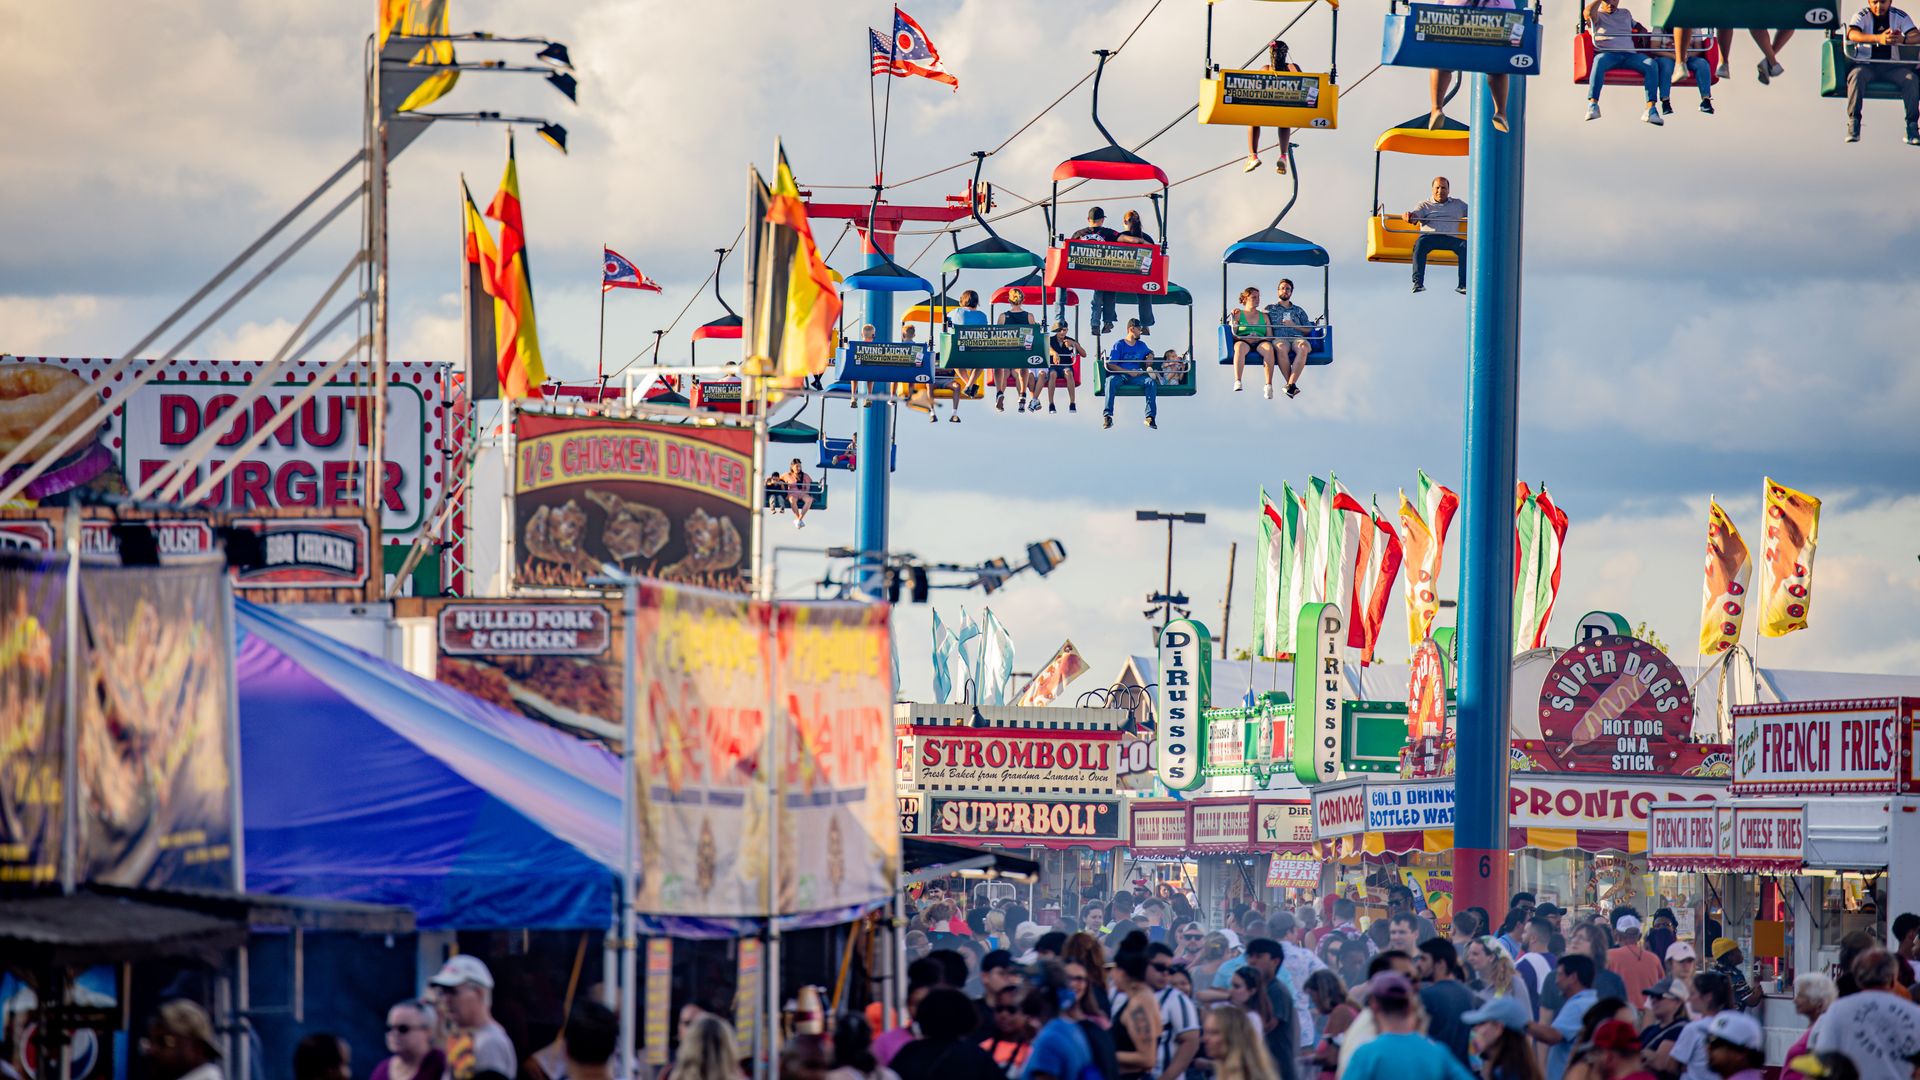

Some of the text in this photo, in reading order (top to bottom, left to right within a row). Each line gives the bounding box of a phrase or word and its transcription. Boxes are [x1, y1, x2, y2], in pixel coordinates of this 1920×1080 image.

[1418, 10, 1503, 28] LIVING LUCKY
[1809, 10, 1827, 22] 16
[1417, 25, 1472, 37] PROMOTION
[1515, 56, 1529, 66] 15
[1226, 77, 1300, 91] LIVING LUCKY
[1226, 88, 1274, 99] PROMOTION
[1313, 119, 1327, 127] 14
[1070, 246, 1136, 260] LIVING LUCKY
[1071, 257, 1112, 267] PROMOTION
[1146, 283, 1157, 291] 13
[959, 330, 1018, 339] LIVING LUCKY
[959, 339, 998, 347] PROMOTION
[856, 345, 910, 355] LIVING LUCKY
[1030, 356, 1041, 364] 12
[704, 385, 727, 393] LIVING
[160, 394, 378, 447] DONUT
[522, 437, 747, 498] 1/2 CHICKEN DINNER
[152, 527, 200, 552] OLISH
[266, 531, 355, 570] BBQ CHICKEN
[456, 610, 593, 629] PULLED PORK
[472, 630, 577, 649] & CHICKEN
[1551, 650, 1680, 714] SUPER DOGS
[1323, 616, 1341, 774] DiRusso's
[1165, 631, 1191, 779] DiRusso's
[1602, 719, 1663, 736] HOT DOG
[1617, 737, 1649, 753] ON A
[1737, 720, 1759, 759] Fresh
[1762, 717, 1892, 773] FRENCH FRIES
[921, 738, 1110, 771] STROMBOLI
[1612, 754, 1655, 771] STICK
[922, 767, 945, 780] Fresh
[949, 768, 976, 780] Baked
[977, 769, 998, 781] from
[1001, 770, 1040, 781] Grandma
[1088, 772, 1109, 782] Oven
[1741, 754, 1756, 778] Cut
[1372, 791, 1400, 807] COLD
[1319, 793, 1364, 827] CORN DOGS
[1370, 808, 1420, 827] BOTTLED
[1656, 817, 1713, 848] FRENCH FRIES
[1740, 818, 1803, 849] CHEESE FRIES
[1269, 868, 1320, 880] STEAK
[1272, 860, 1321, 871] CHEESE
[1478, 854, 1491, 879] 6
[1269, 879, 1317, 888] MADE FRESH
